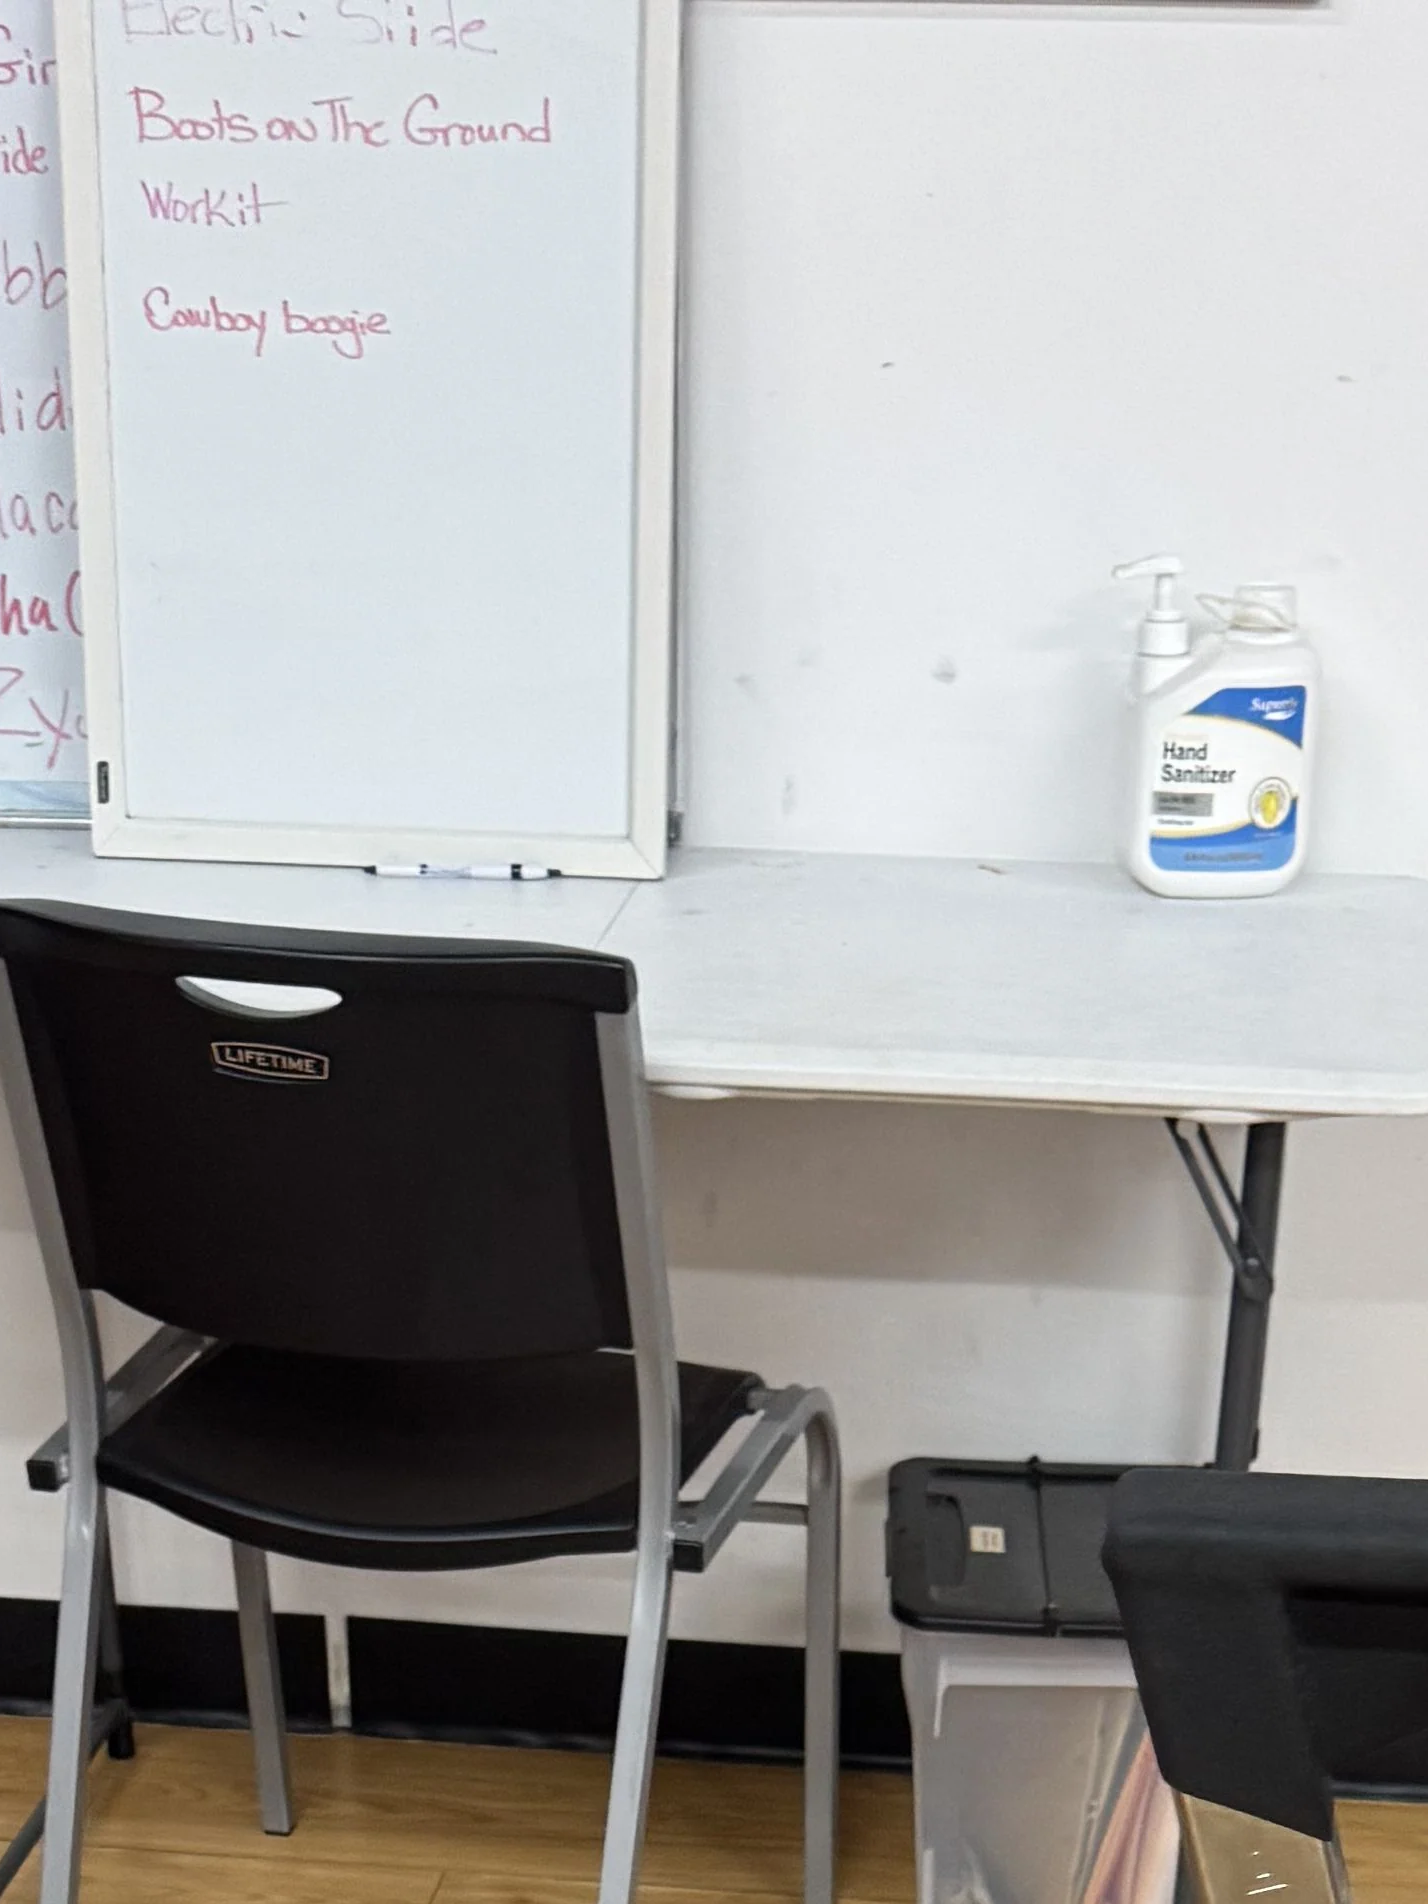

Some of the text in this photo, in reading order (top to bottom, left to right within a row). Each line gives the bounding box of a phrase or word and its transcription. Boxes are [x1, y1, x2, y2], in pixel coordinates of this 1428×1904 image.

[128, 86, 259, 143] Boots
[312, 96, 390, 148] The
[403, 93, 551, 147] Ground
[143, 286, 392, 360] Cowboy boogie
[1162, 742, 1209, 762] Hand
[1161, 764, 1237, 784] Sanitizer
[224, 1047, 317, 1074] LIFETIME
